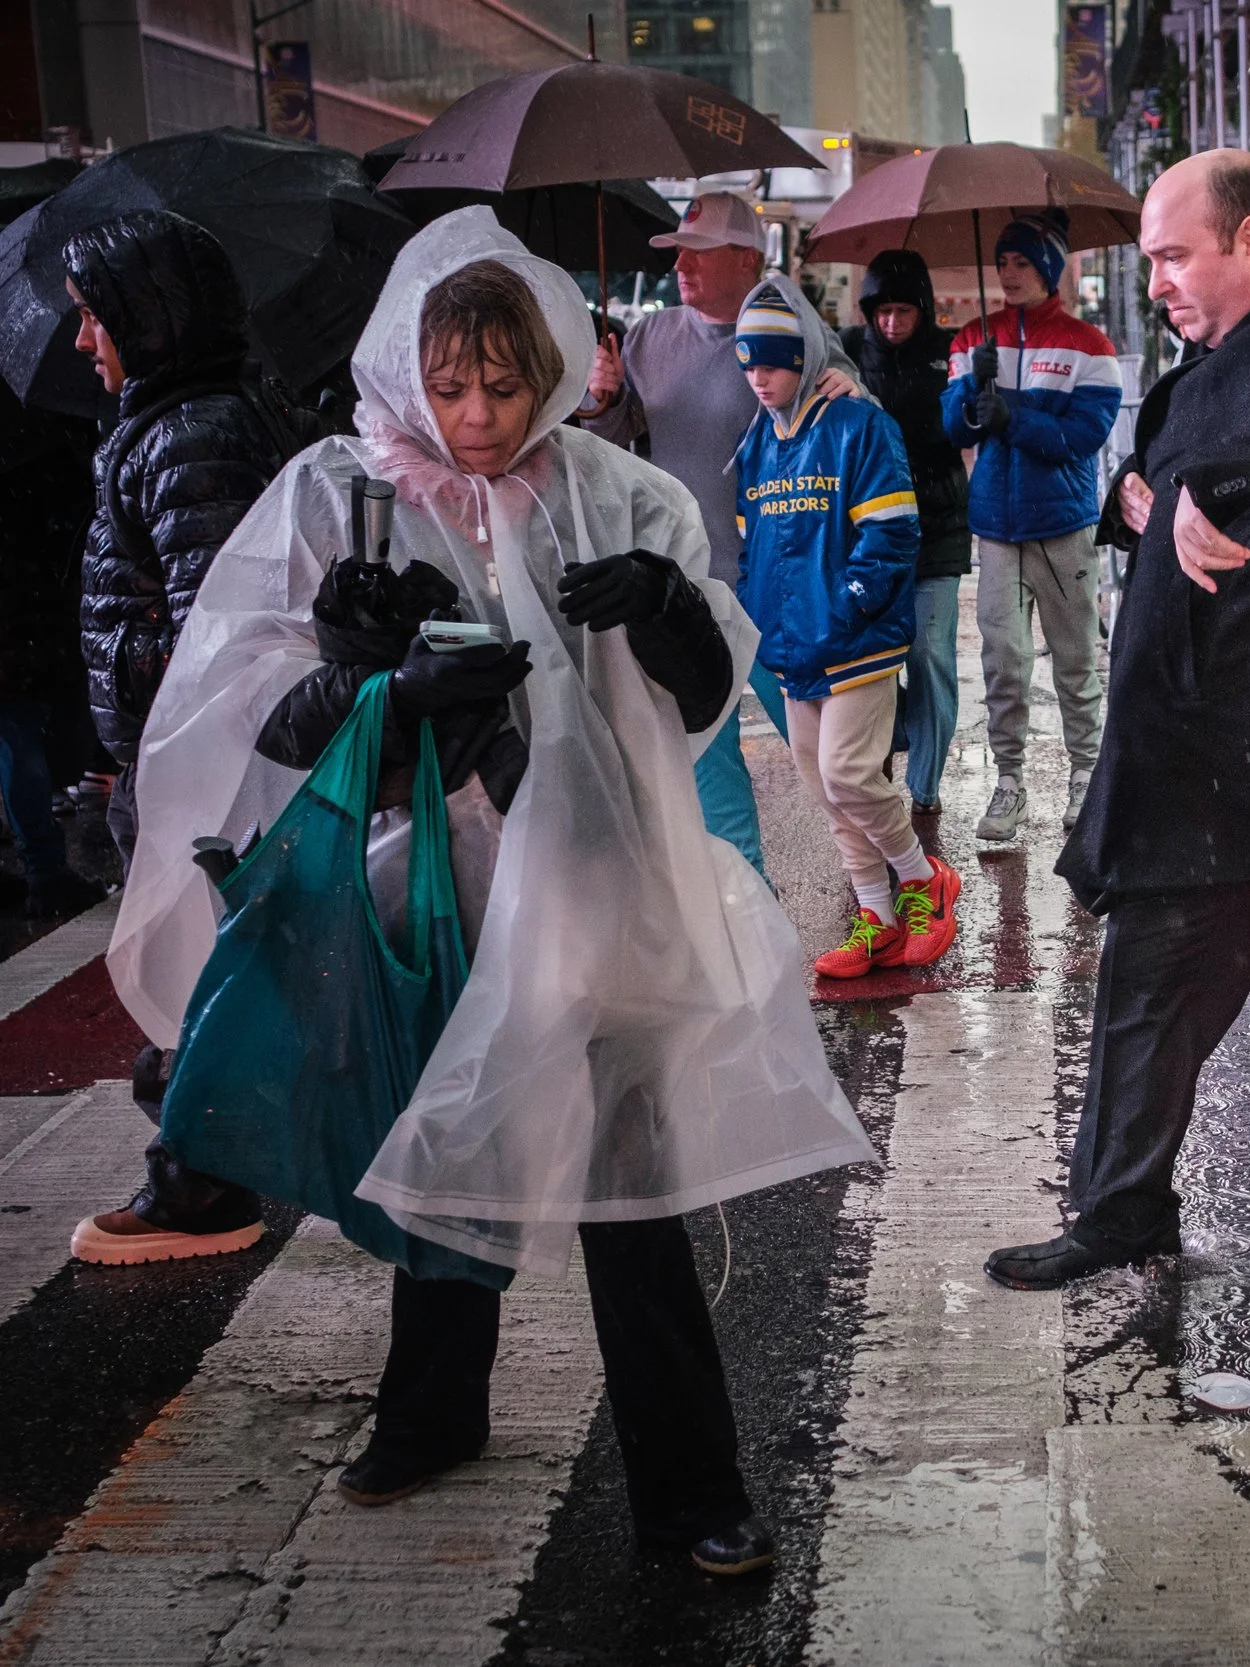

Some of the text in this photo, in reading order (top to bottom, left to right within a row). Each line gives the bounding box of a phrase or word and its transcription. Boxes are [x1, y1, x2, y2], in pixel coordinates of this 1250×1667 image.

[1031, 360, 1072, 376] BILLS
[746, 475, 841, 501] GOLDEN STATE
